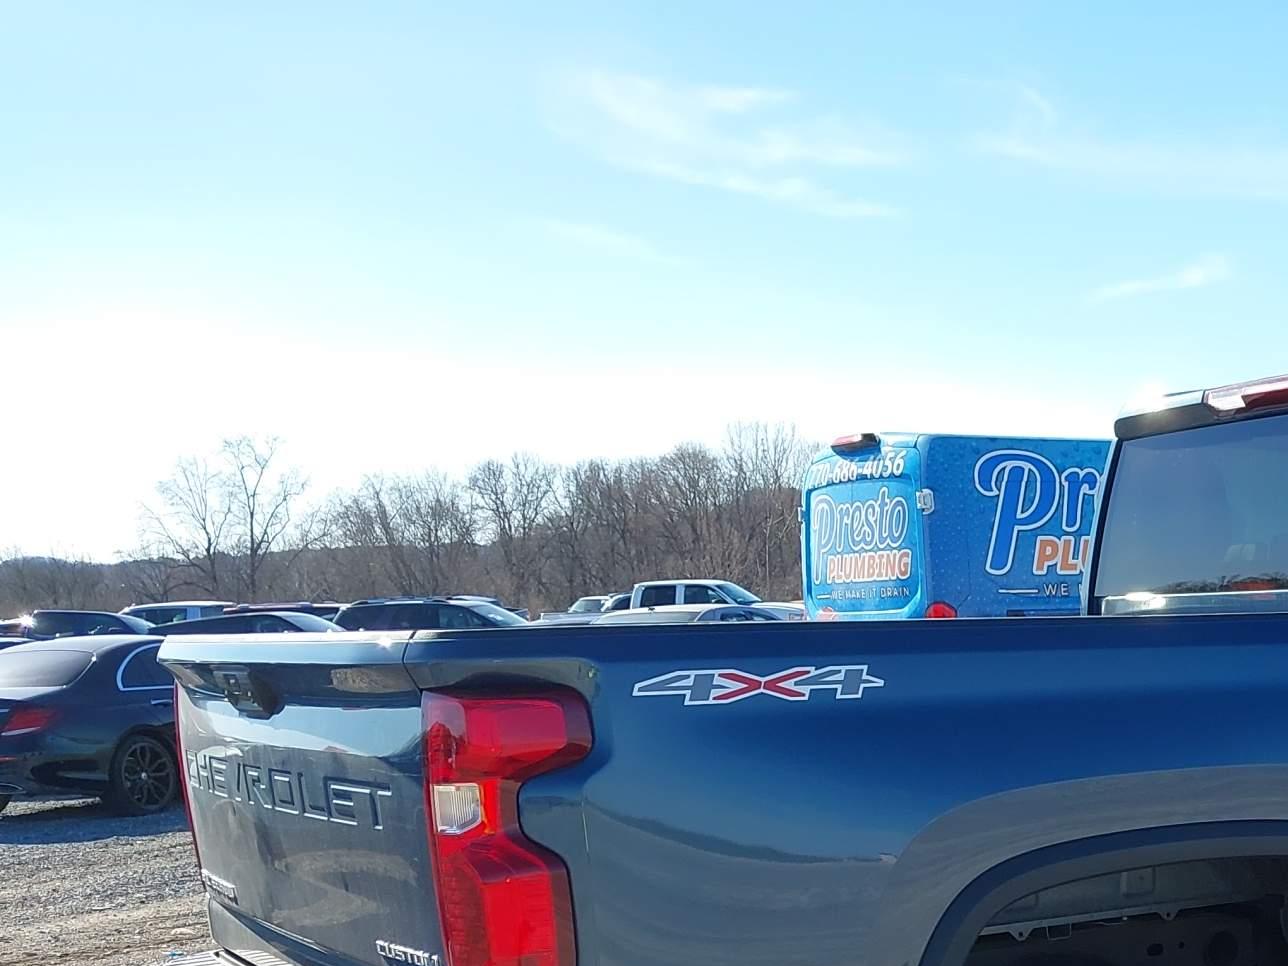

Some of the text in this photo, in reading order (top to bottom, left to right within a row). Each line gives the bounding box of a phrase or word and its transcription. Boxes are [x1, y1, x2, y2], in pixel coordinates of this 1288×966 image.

[974, 449, 1104, 576] Pr
[813, 486, 909, 585] Presto
[826, 549, 912, 584] PLUMBING
[831, 586, 910, 600] WE MAKE IT DRAIN
[1043, 583, 1068, 596] WE
